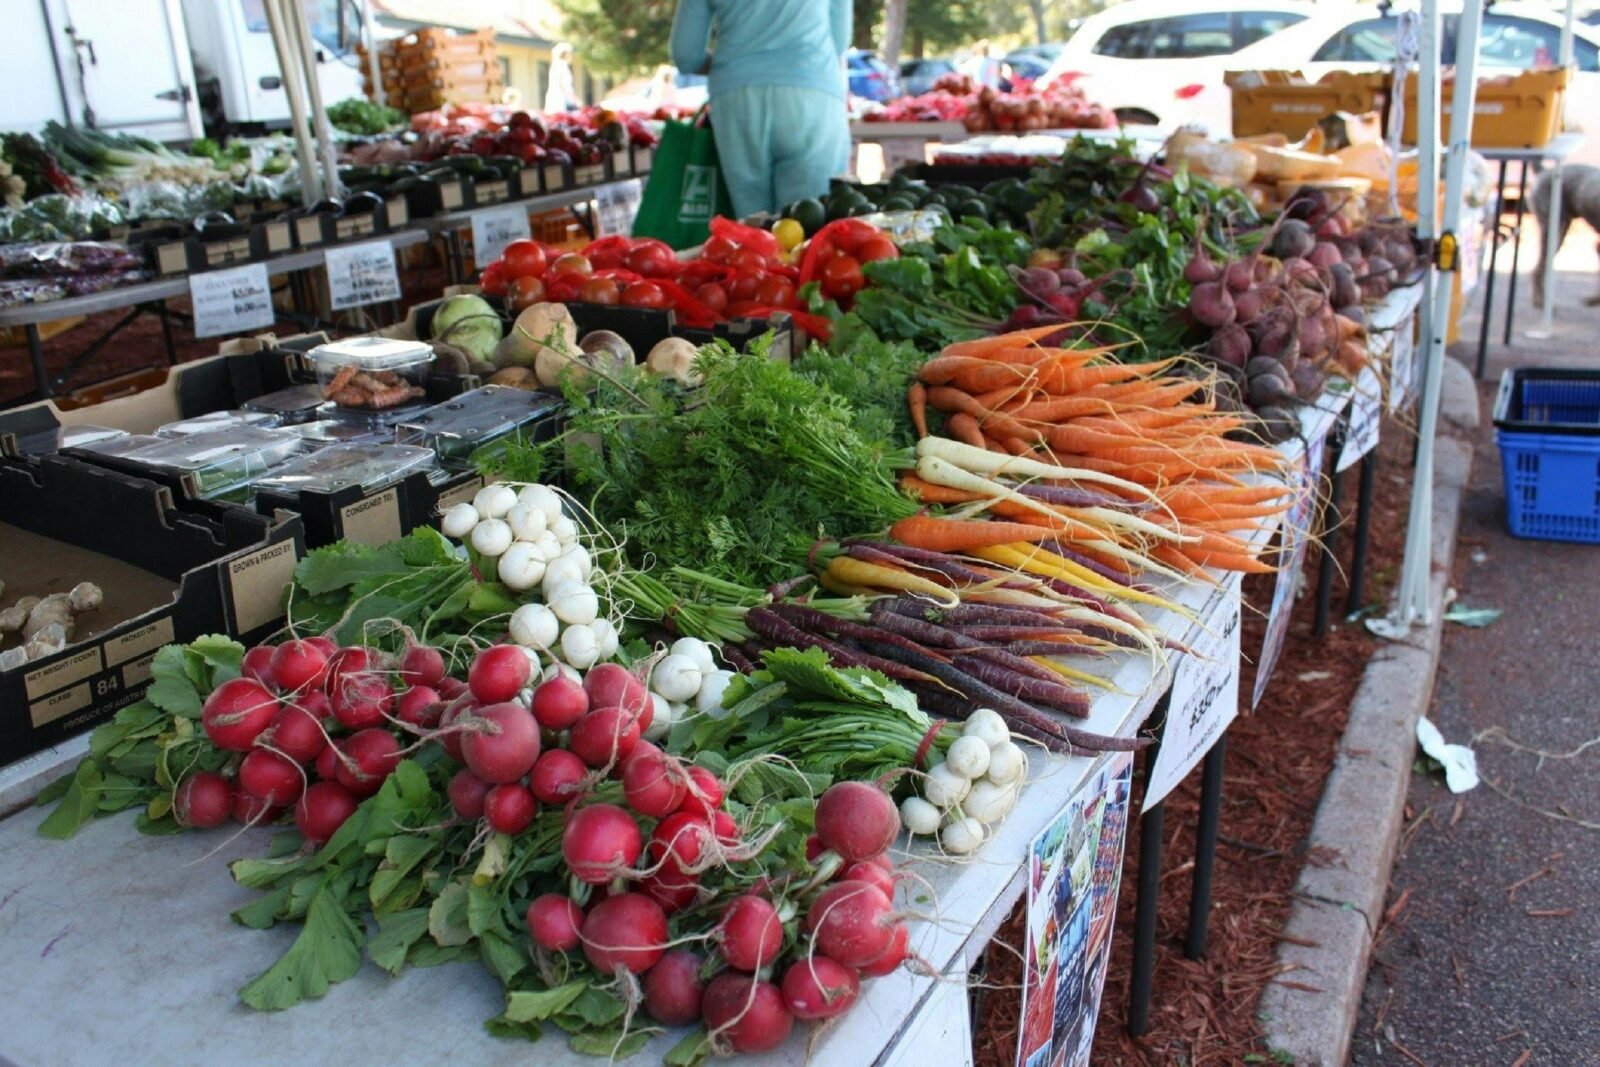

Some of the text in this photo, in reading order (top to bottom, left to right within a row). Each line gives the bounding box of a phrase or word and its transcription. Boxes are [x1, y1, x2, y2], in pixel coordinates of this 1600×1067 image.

[345, 493, 393, 518] CONSIGNED TO:
[233, 558, 255, 574] GROWN
[260, 547, 282, 562] PACKED
[121, 630, 146, 644] PACKED
[27, 672, 41, 682] NET
[43, 661, 69, 675] WEIGHT
[96, 675, 118, 696] 84
[63, 707, 103, 730] PRODUCE
[104, 702, 114, 713] OF
